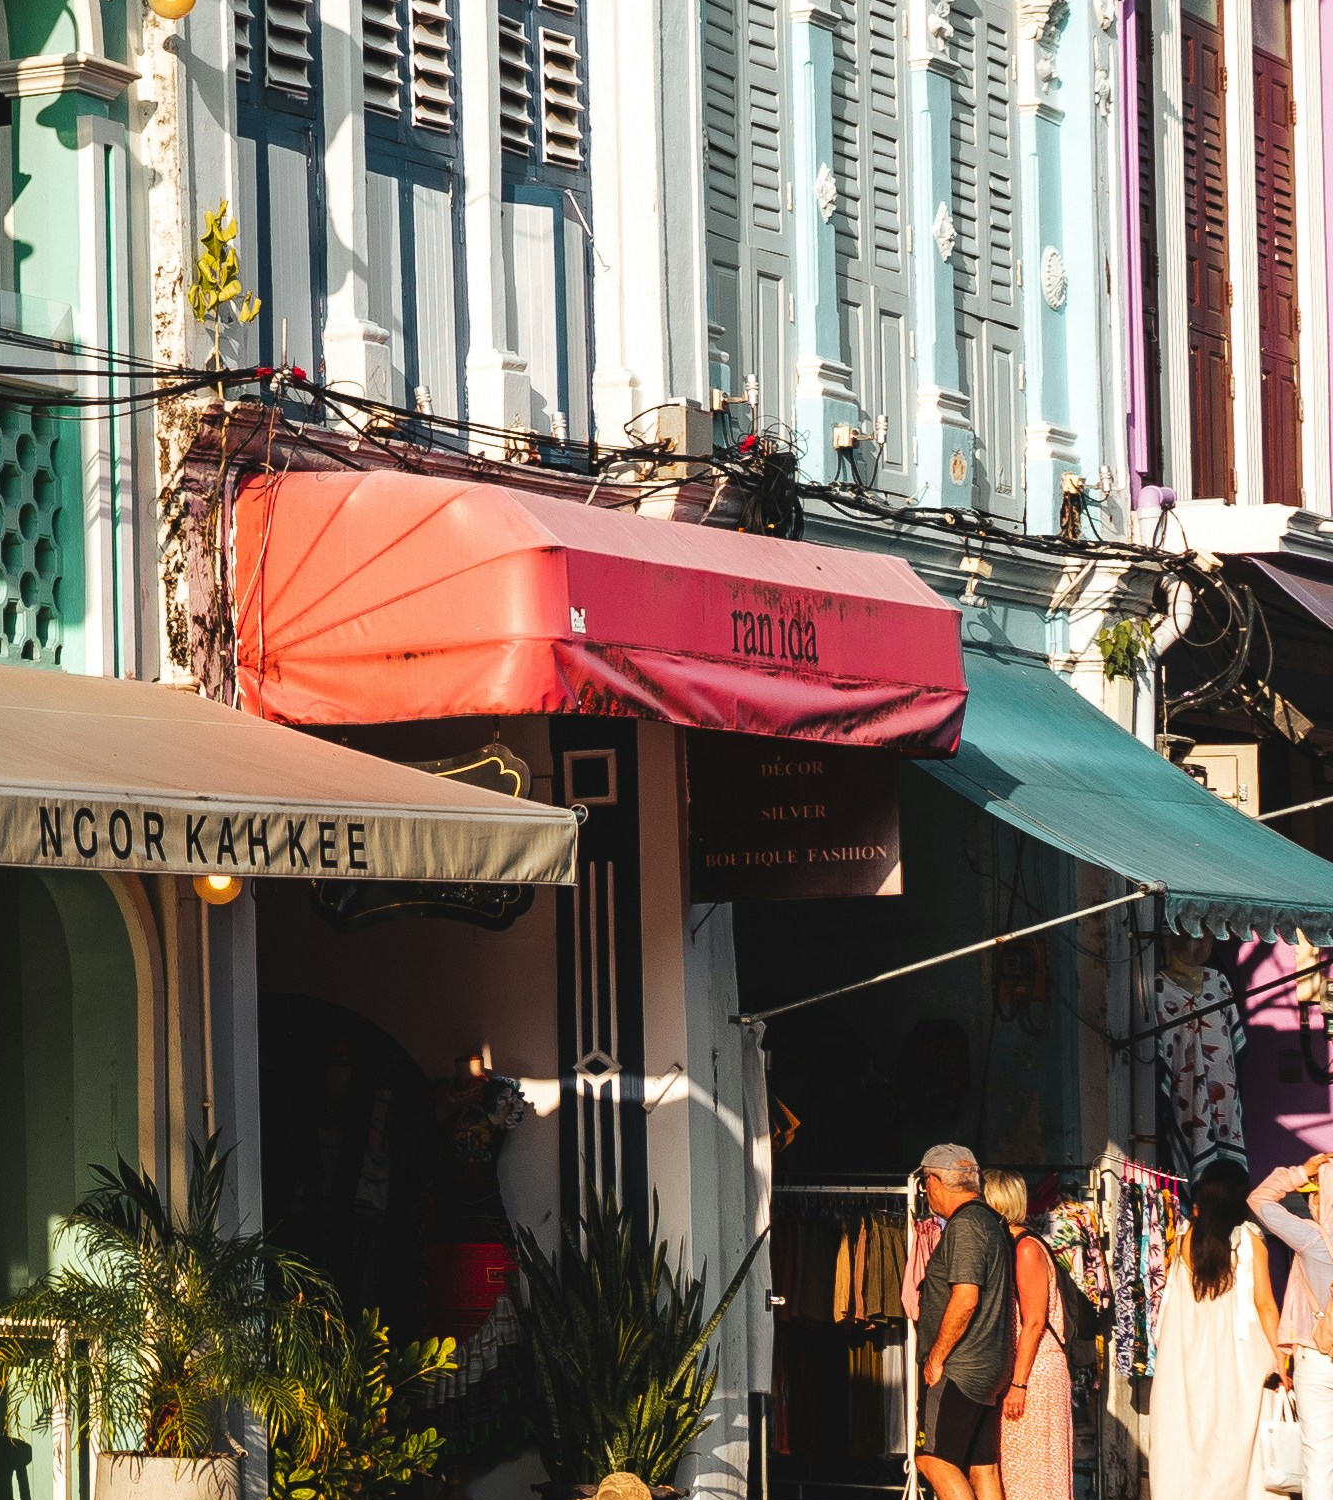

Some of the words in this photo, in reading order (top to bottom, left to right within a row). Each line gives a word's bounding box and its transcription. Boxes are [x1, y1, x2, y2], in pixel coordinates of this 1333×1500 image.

[761, 755, 824, 778] DÉCOR
[761, 803, 827, 821] SILVER
[38, 804, 169, 862] NGOR
[184, 814, 271, 867] KAH
[287, 819, 369, 870] KEE
[705, 847, 799, 869] BOUTIQUE
[808, 843, 889, 864] FASHION
